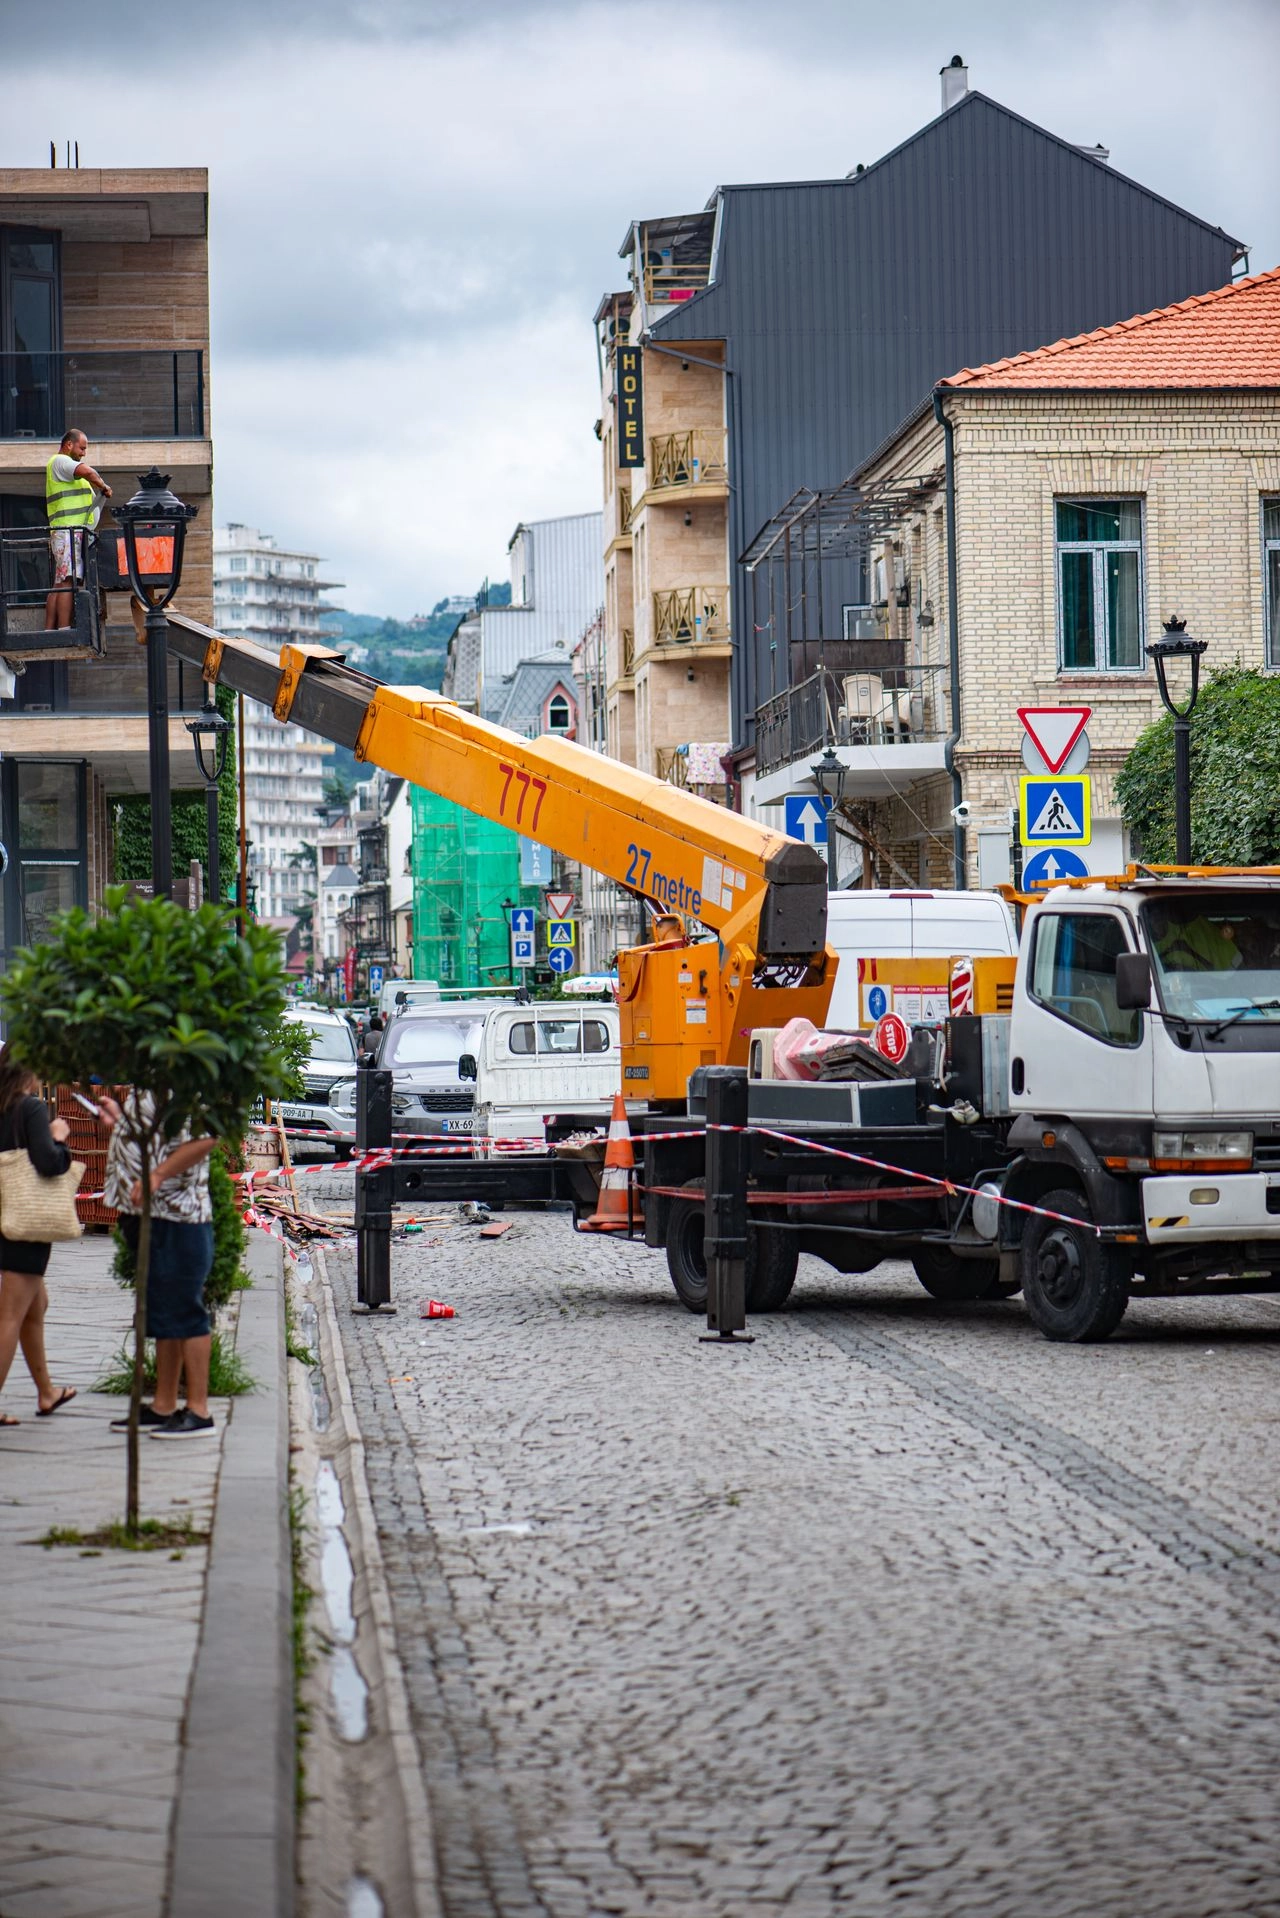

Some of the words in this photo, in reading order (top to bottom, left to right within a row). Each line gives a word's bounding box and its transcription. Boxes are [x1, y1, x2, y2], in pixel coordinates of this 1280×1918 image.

[622, 353, 638, 461] HOTEL
[499, 763, 547, 832] 777
[531, 841, 541, 878] MLAB
[625, 843, 652, 889] 27
[652, 871, 702, 915] metre
[518, 942, 528, 955] P
[884, 1022, 897, 1055] STOP
[448, 1119, 474, 1130] XX-69
